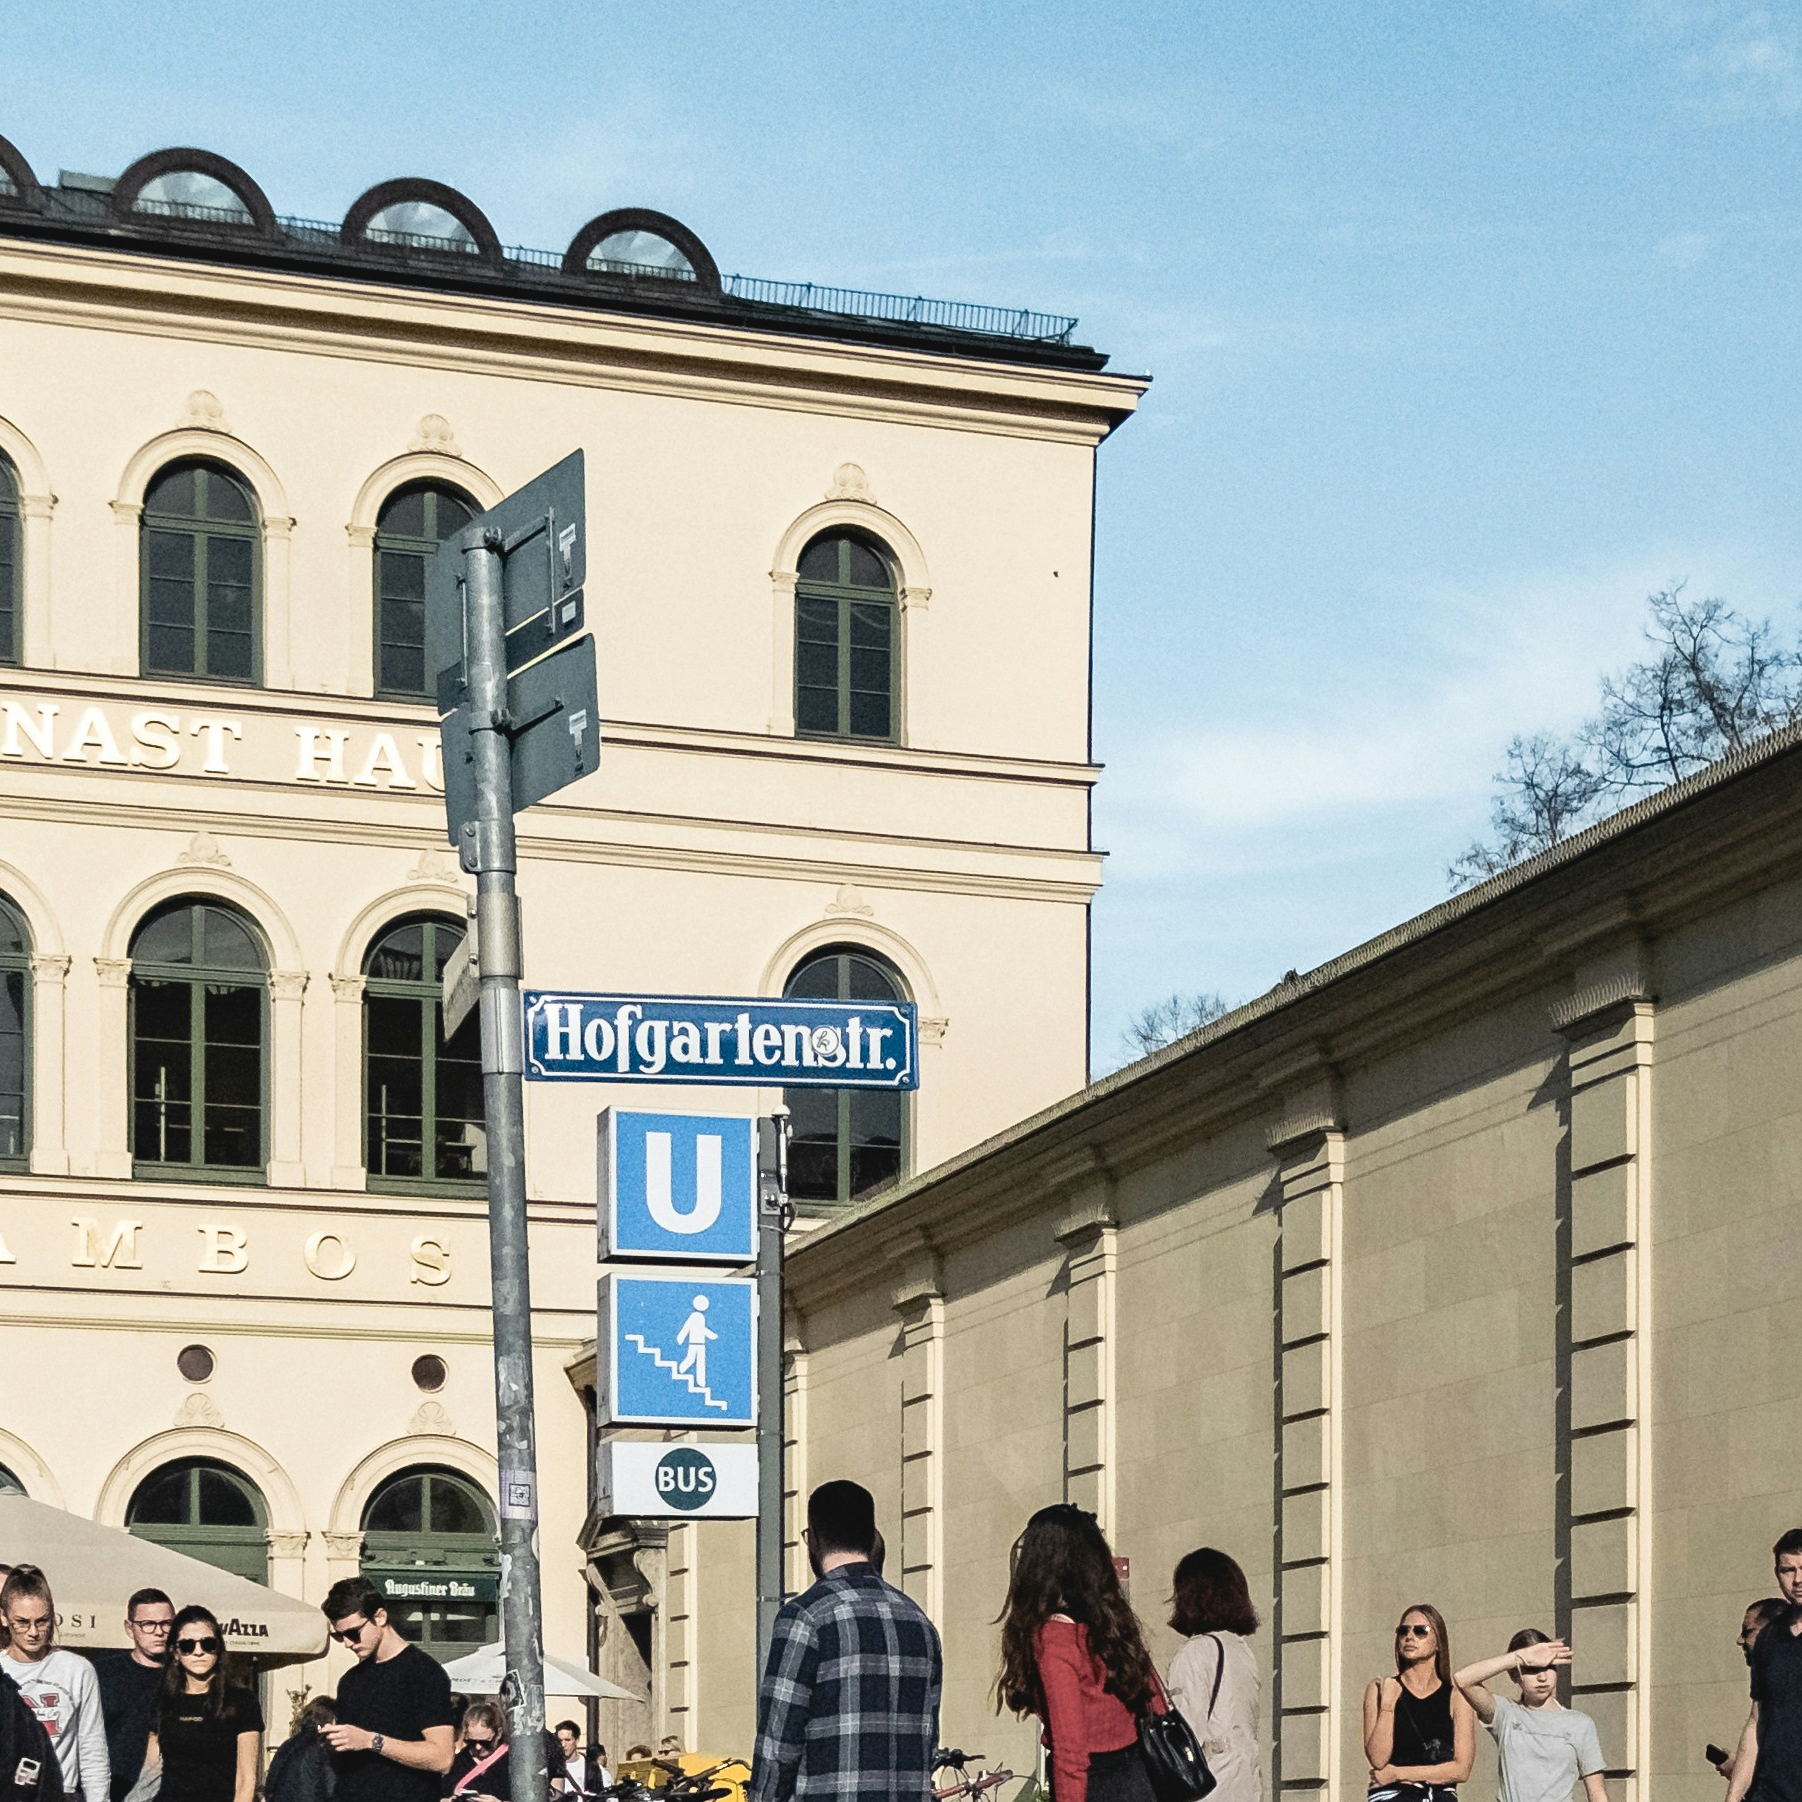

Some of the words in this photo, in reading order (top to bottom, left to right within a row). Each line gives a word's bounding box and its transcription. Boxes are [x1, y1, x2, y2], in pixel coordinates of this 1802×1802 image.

[646, 1132, 722, 1234] U
[656, 1466, 715, 1491] BUS
[384, 1579, 449, 1597] Augustiner
